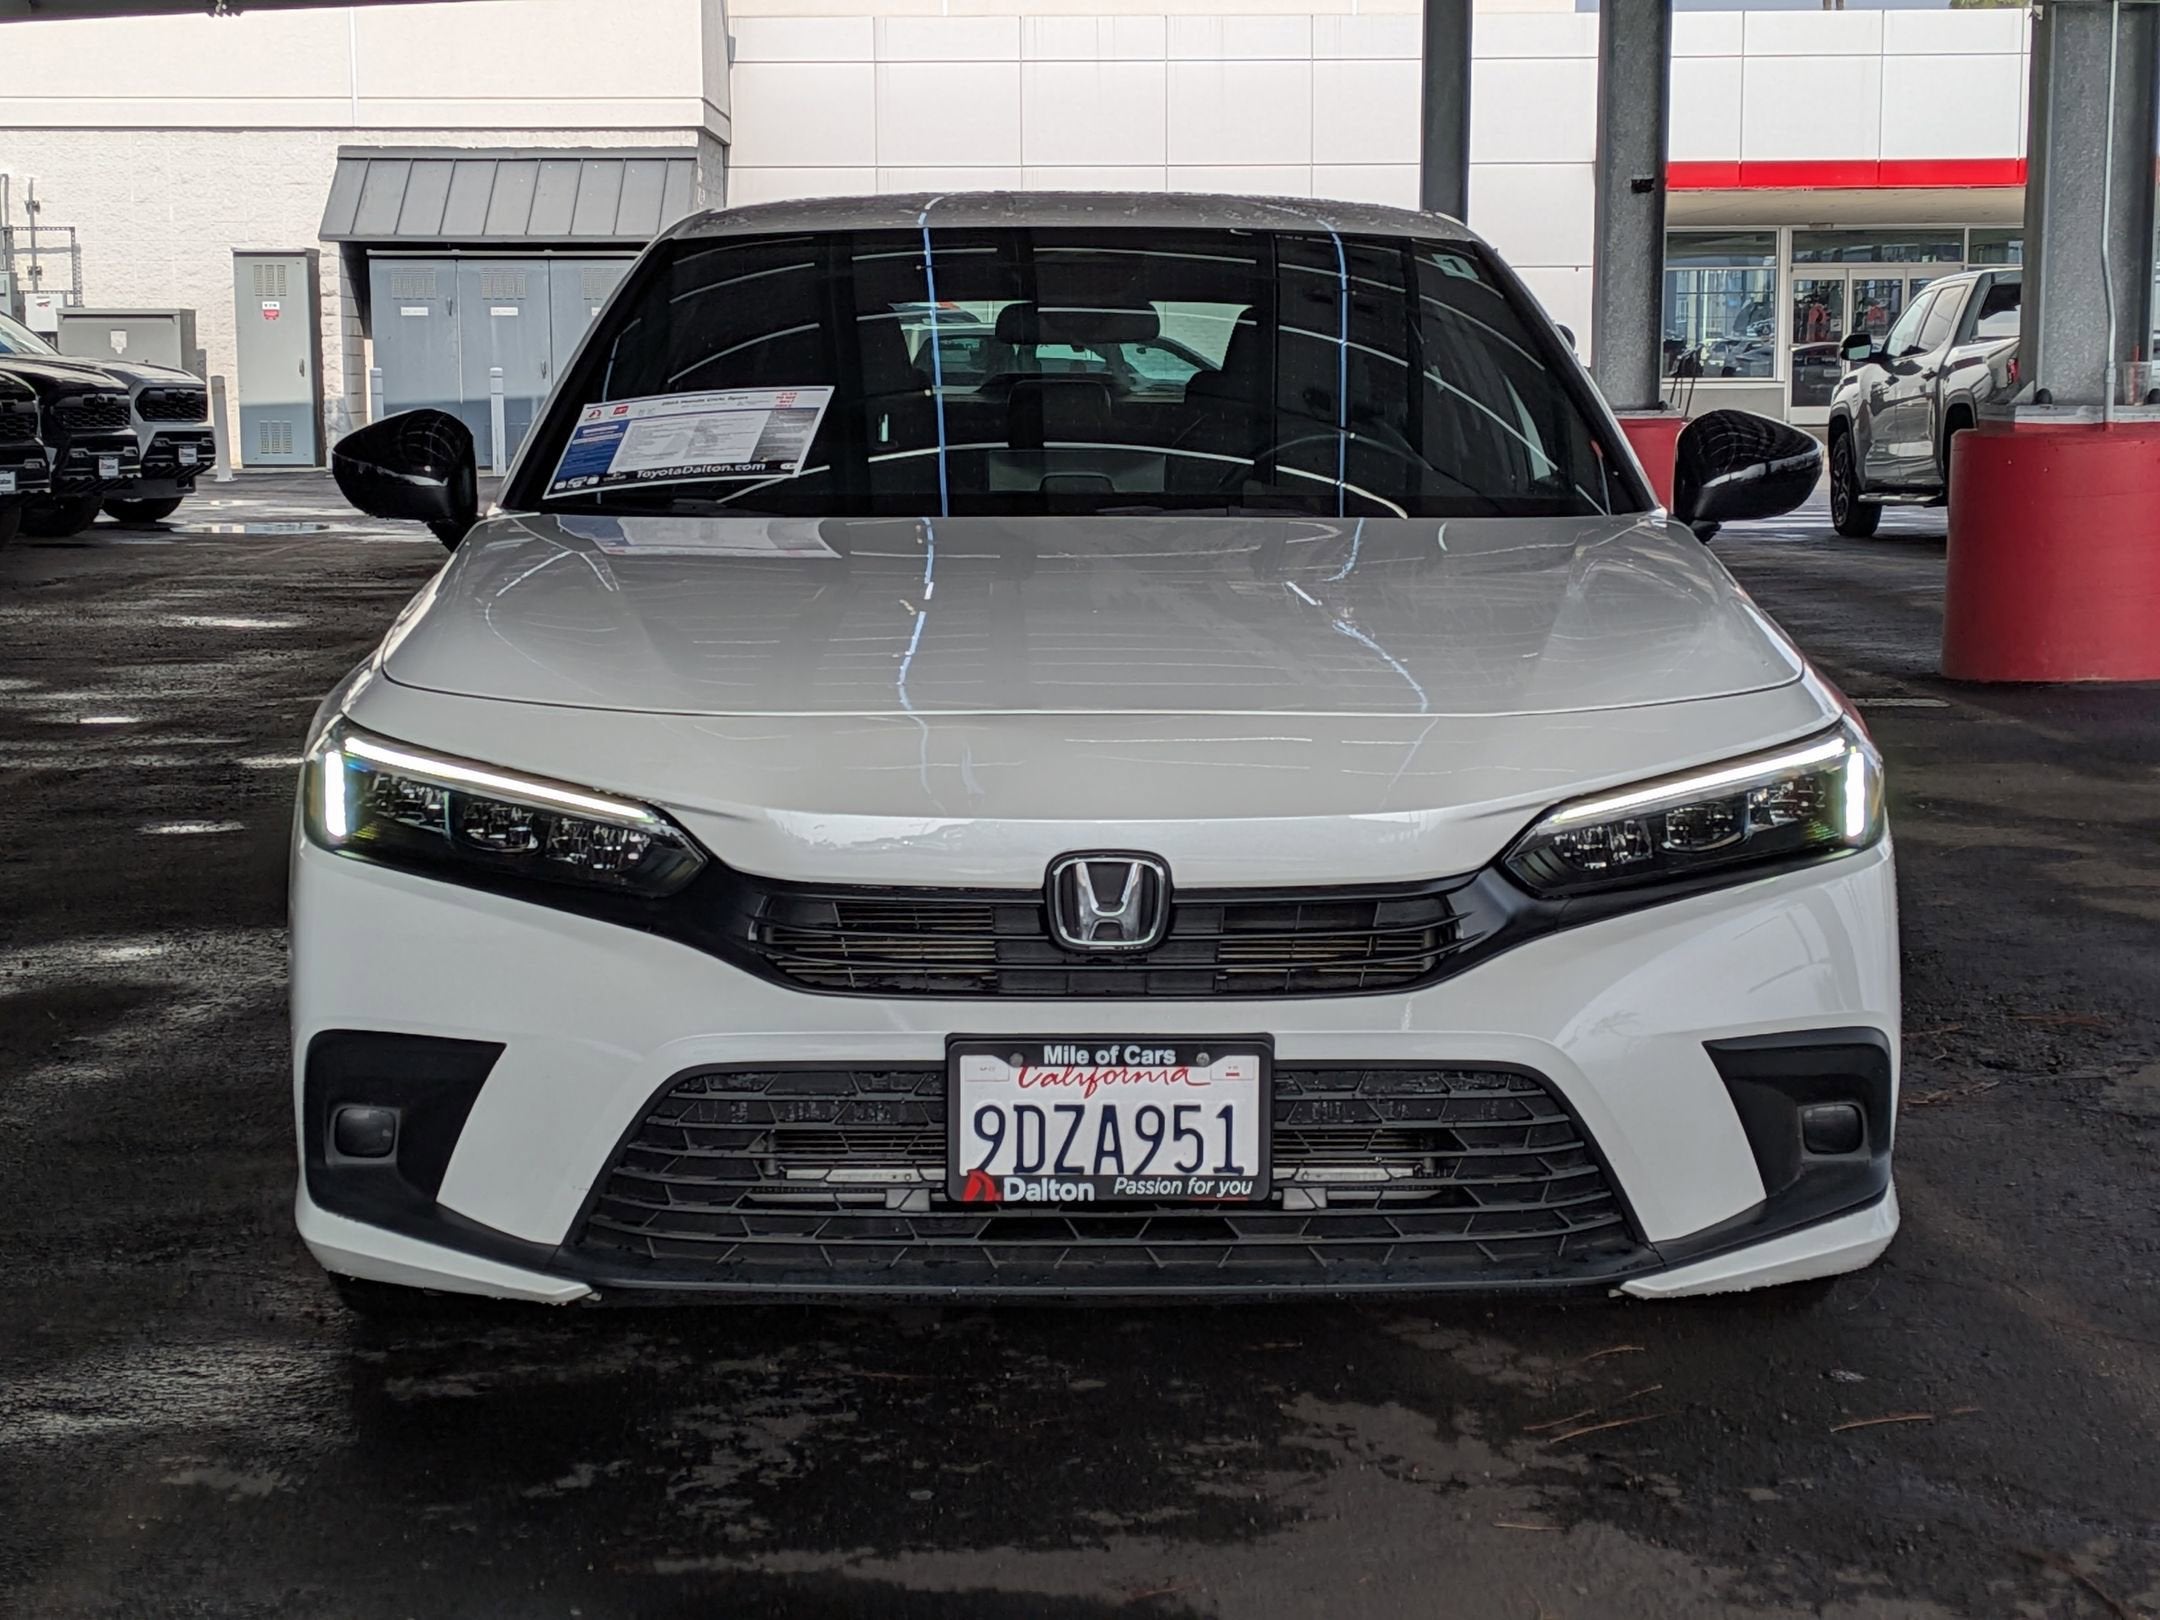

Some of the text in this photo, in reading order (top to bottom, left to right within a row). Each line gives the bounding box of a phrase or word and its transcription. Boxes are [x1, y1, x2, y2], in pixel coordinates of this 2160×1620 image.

[636, 462, 766, 479] ToyotaDalton.com
[1043, 1045, 1176, 1065] Mile of Cars
[1017, 1065, 1211, 1099] California
[972, 1104, 1245, 1176] 9DZA951
[1003, 1177, 1095, 1202] Dalton
[1113, 1176, 1253, 1198] Passion for you
